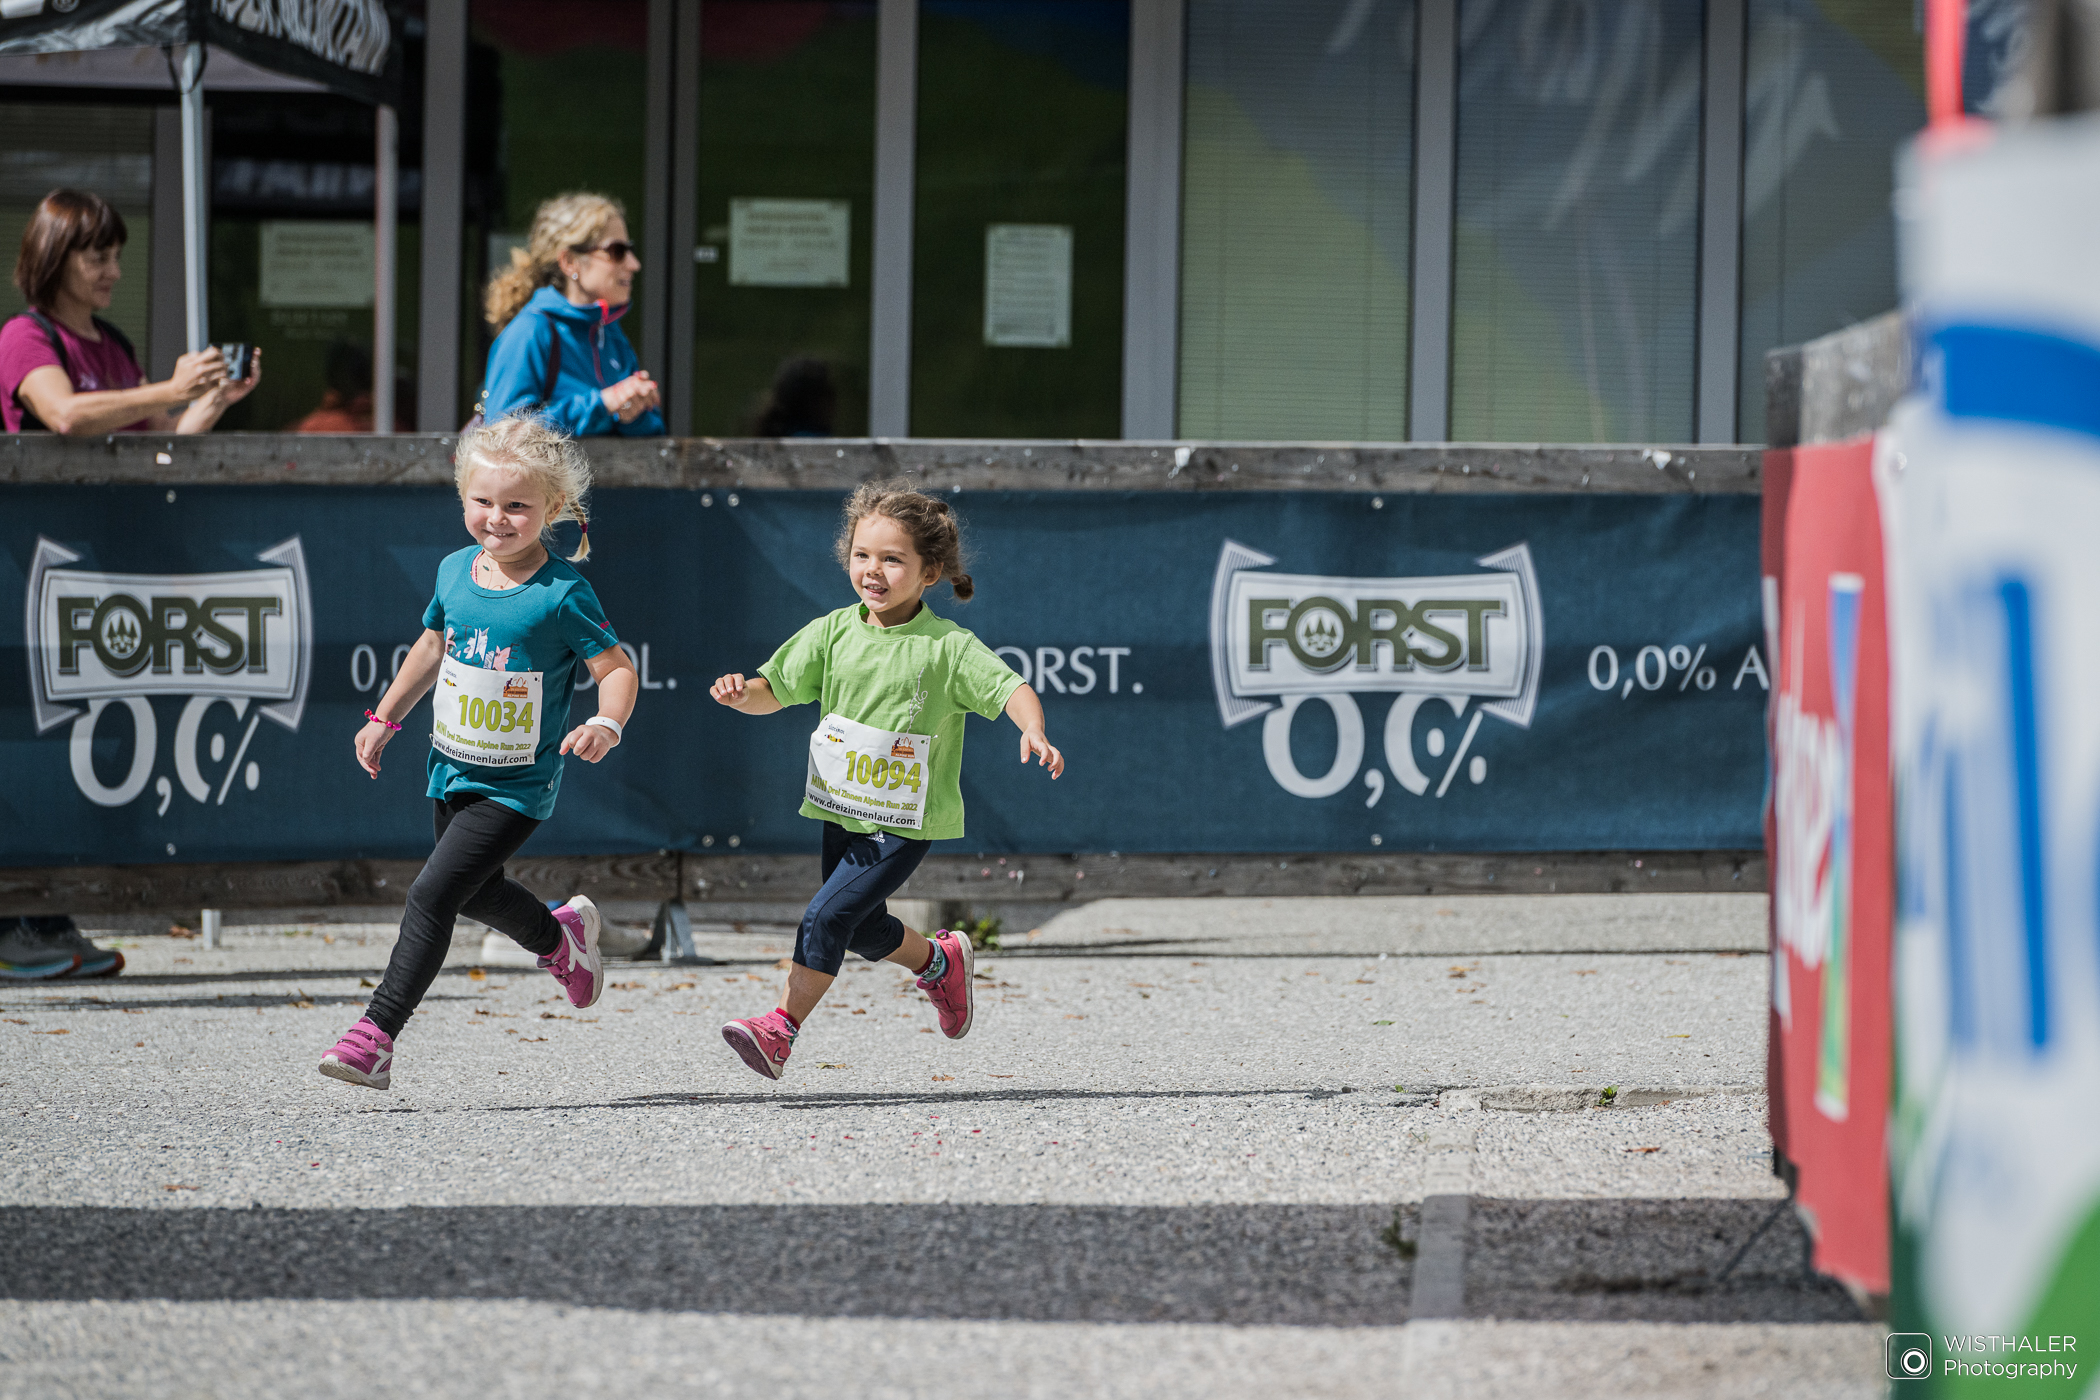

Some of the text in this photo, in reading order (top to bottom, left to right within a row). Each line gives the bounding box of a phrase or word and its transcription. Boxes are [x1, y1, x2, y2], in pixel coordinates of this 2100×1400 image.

[57, 594, 282, 676] FORST
[1247, 596, 1507, 674] FORST
[1587, 643, 1717, 700] 0,0%
[459, 694, 534, 734] 10034
[434, 739, 528, 764] www.dreizinnenlauf.com
[456, 735, 476, 746] Zinnen
[476, 740, 499, 750] Alpine
[500, 742, 514, 751] Run
[515, 743, 532, 751] 2022
[846, 751, 922, 793] 10094
[808, 792, 917, 826] www.dreizinnenlauf.com
[811, 774, 918, 811] MINI Drei Zinnen Alpine Run 2022
